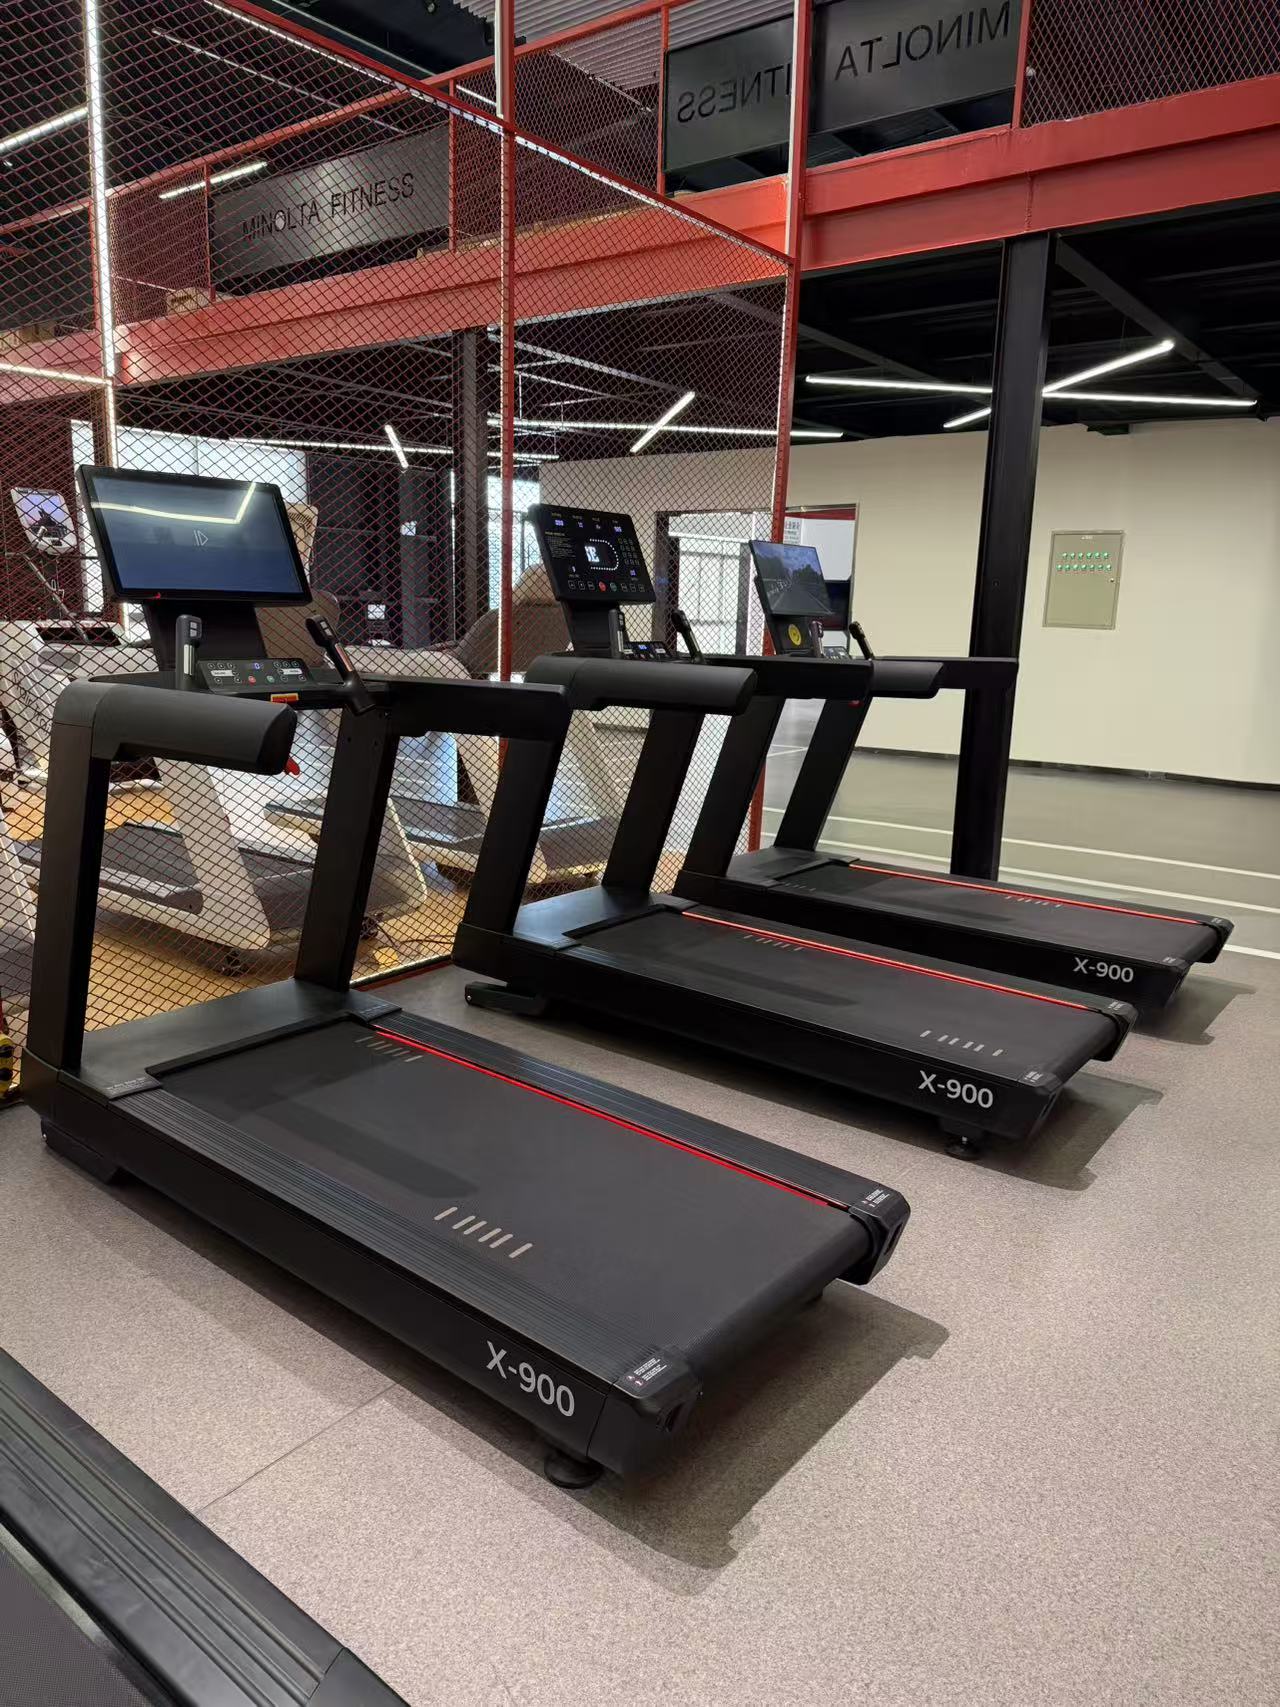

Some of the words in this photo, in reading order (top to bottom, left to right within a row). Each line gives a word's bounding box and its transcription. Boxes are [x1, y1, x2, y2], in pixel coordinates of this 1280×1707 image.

[242, 200, 320, 240] MINOLTA
[331, 172, 414, 218] FITNESS
[1073, 957, 1134, 983] X-900
[918, 1070, 993, 1108] X-900
[486, 1340, 575, 1417] X-900
